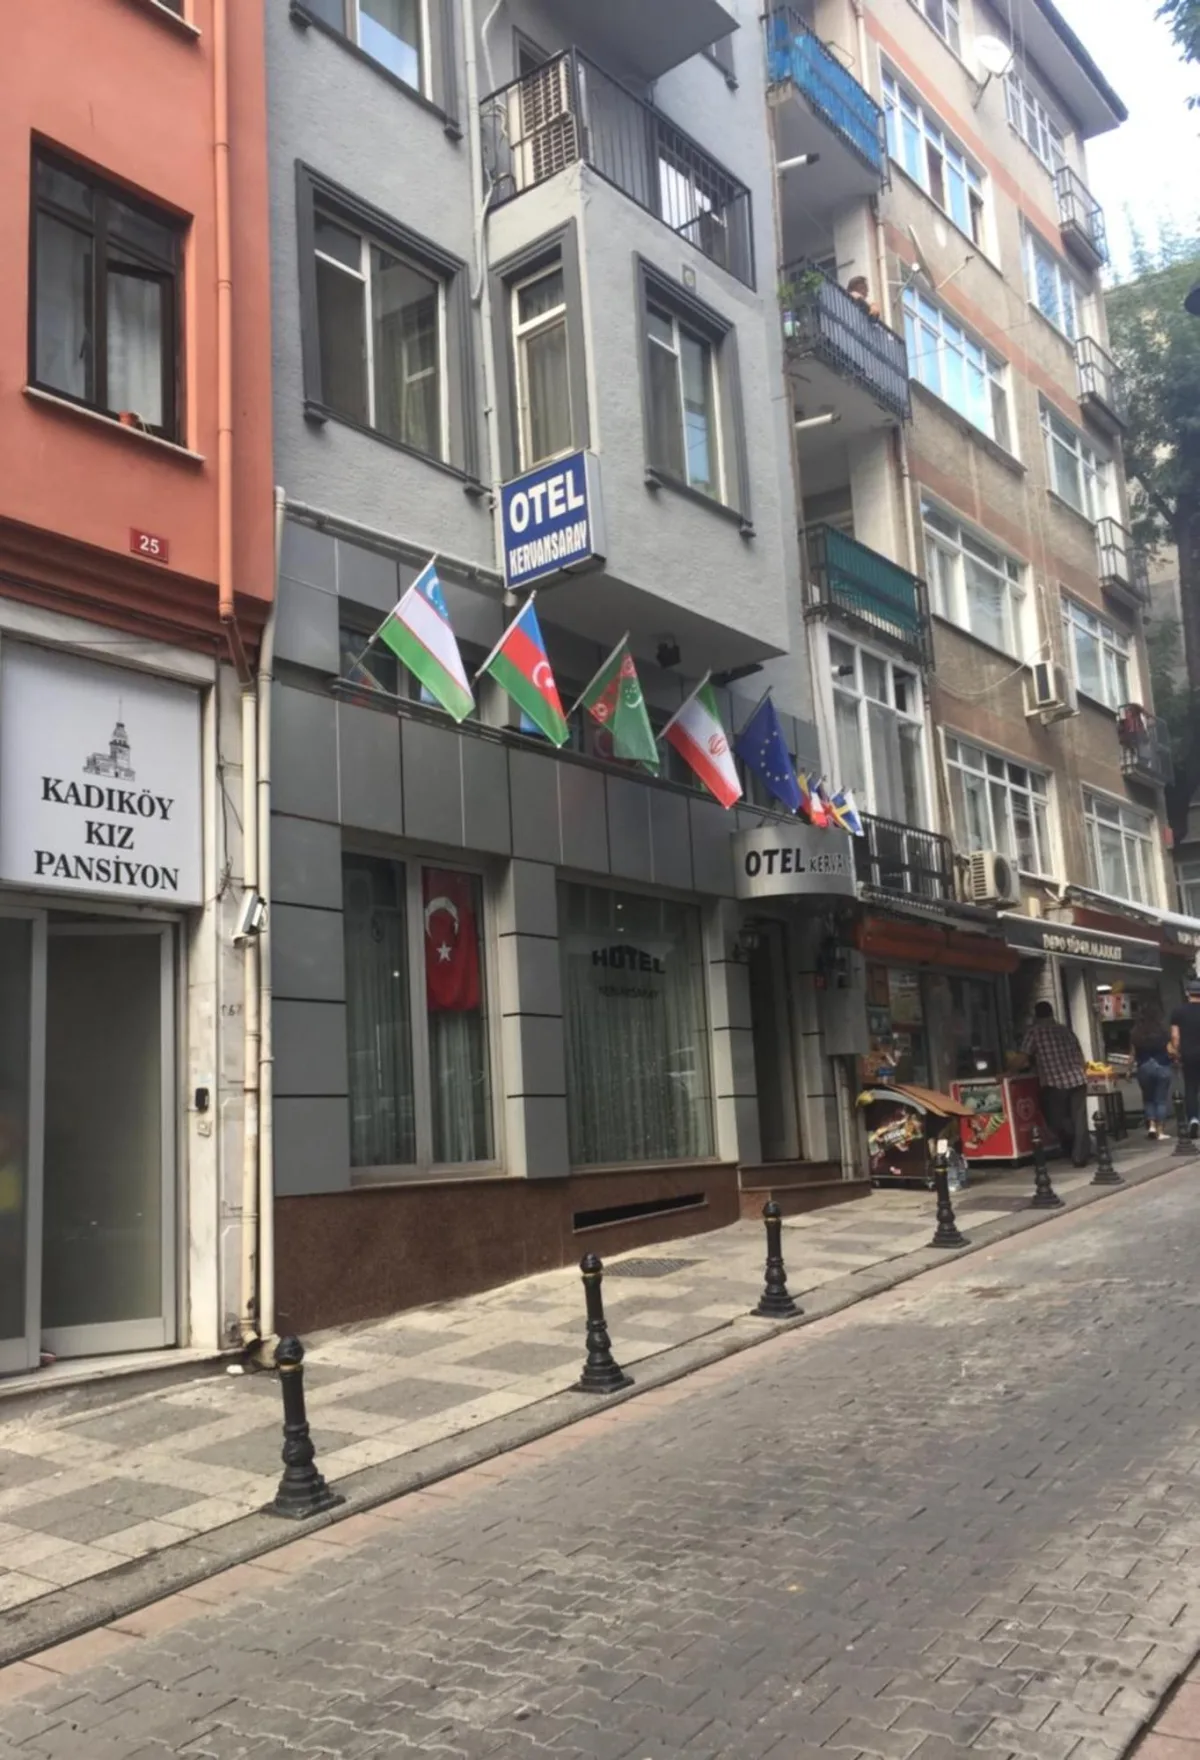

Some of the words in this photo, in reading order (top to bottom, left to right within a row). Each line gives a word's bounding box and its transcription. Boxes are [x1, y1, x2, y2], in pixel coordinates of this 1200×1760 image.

[509, 470, 585, 533] OTEL
[139, 534, 160, 555] 25
[508, 520, 588, 577] KERVANSARAY
[41, 776, 174, 821] KADIKÖY
[84, 820, 135, 850] KIZ
[33, 850, 180, 891] PANSİYON
[745, 848, 806, 877] OTEL
[592, 945, 666, 974] HOTEL
